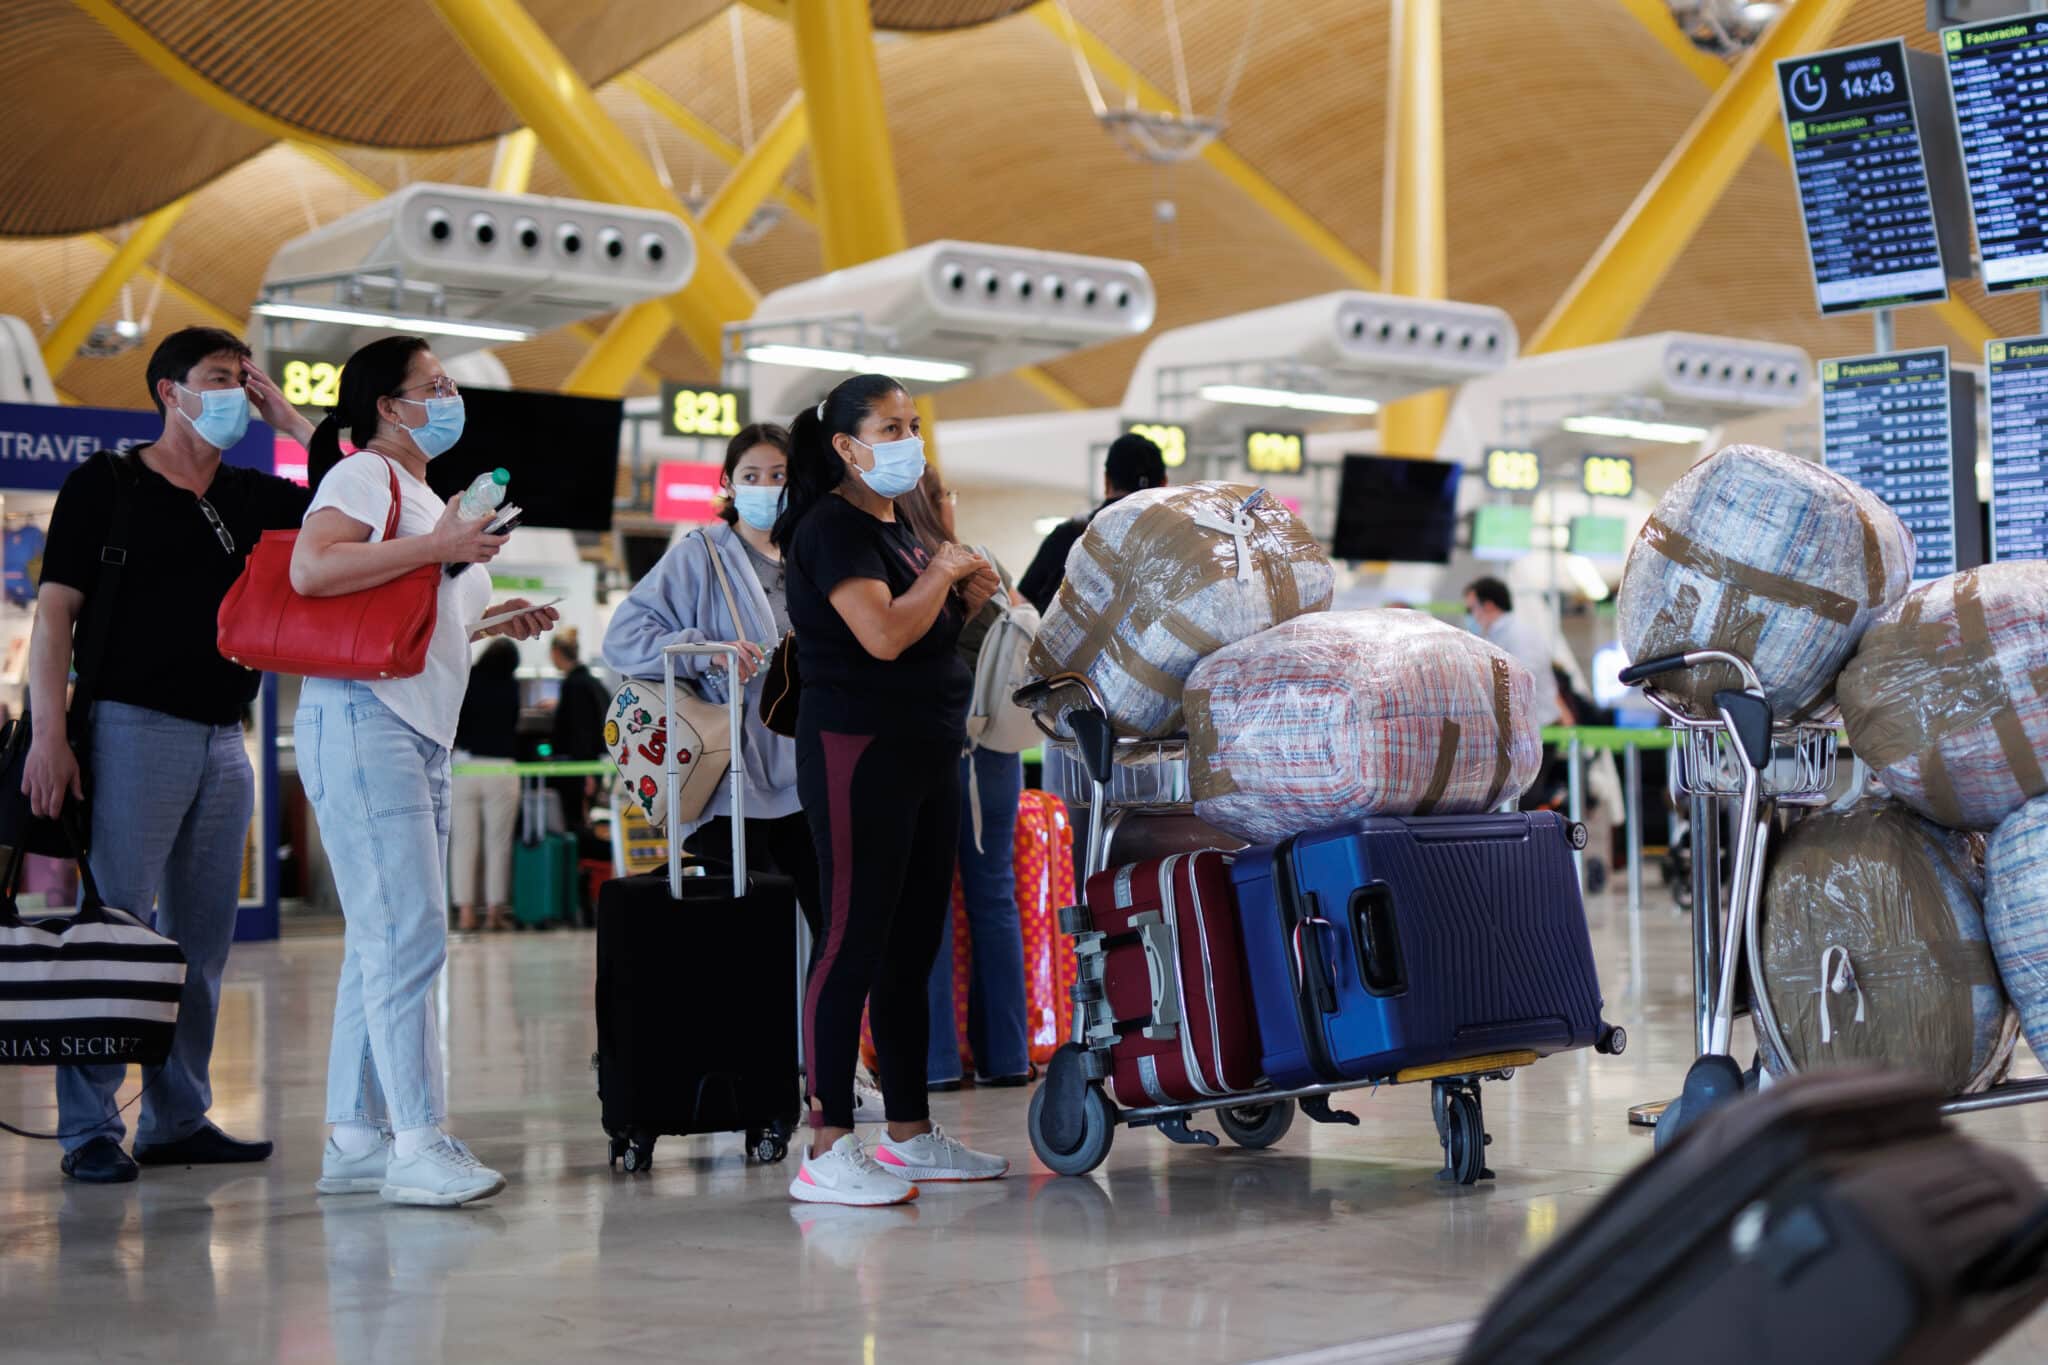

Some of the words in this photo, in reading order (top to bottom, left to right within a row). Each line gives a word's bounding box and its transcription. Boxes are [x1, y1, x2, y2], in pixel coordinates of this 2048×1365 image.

[1840, 71, 1895, 100] 14:43
[1809, 116, 1868, 136] Facturación
[284, 361, 345, 407] 82
[674, 390, 740, 435] 821
